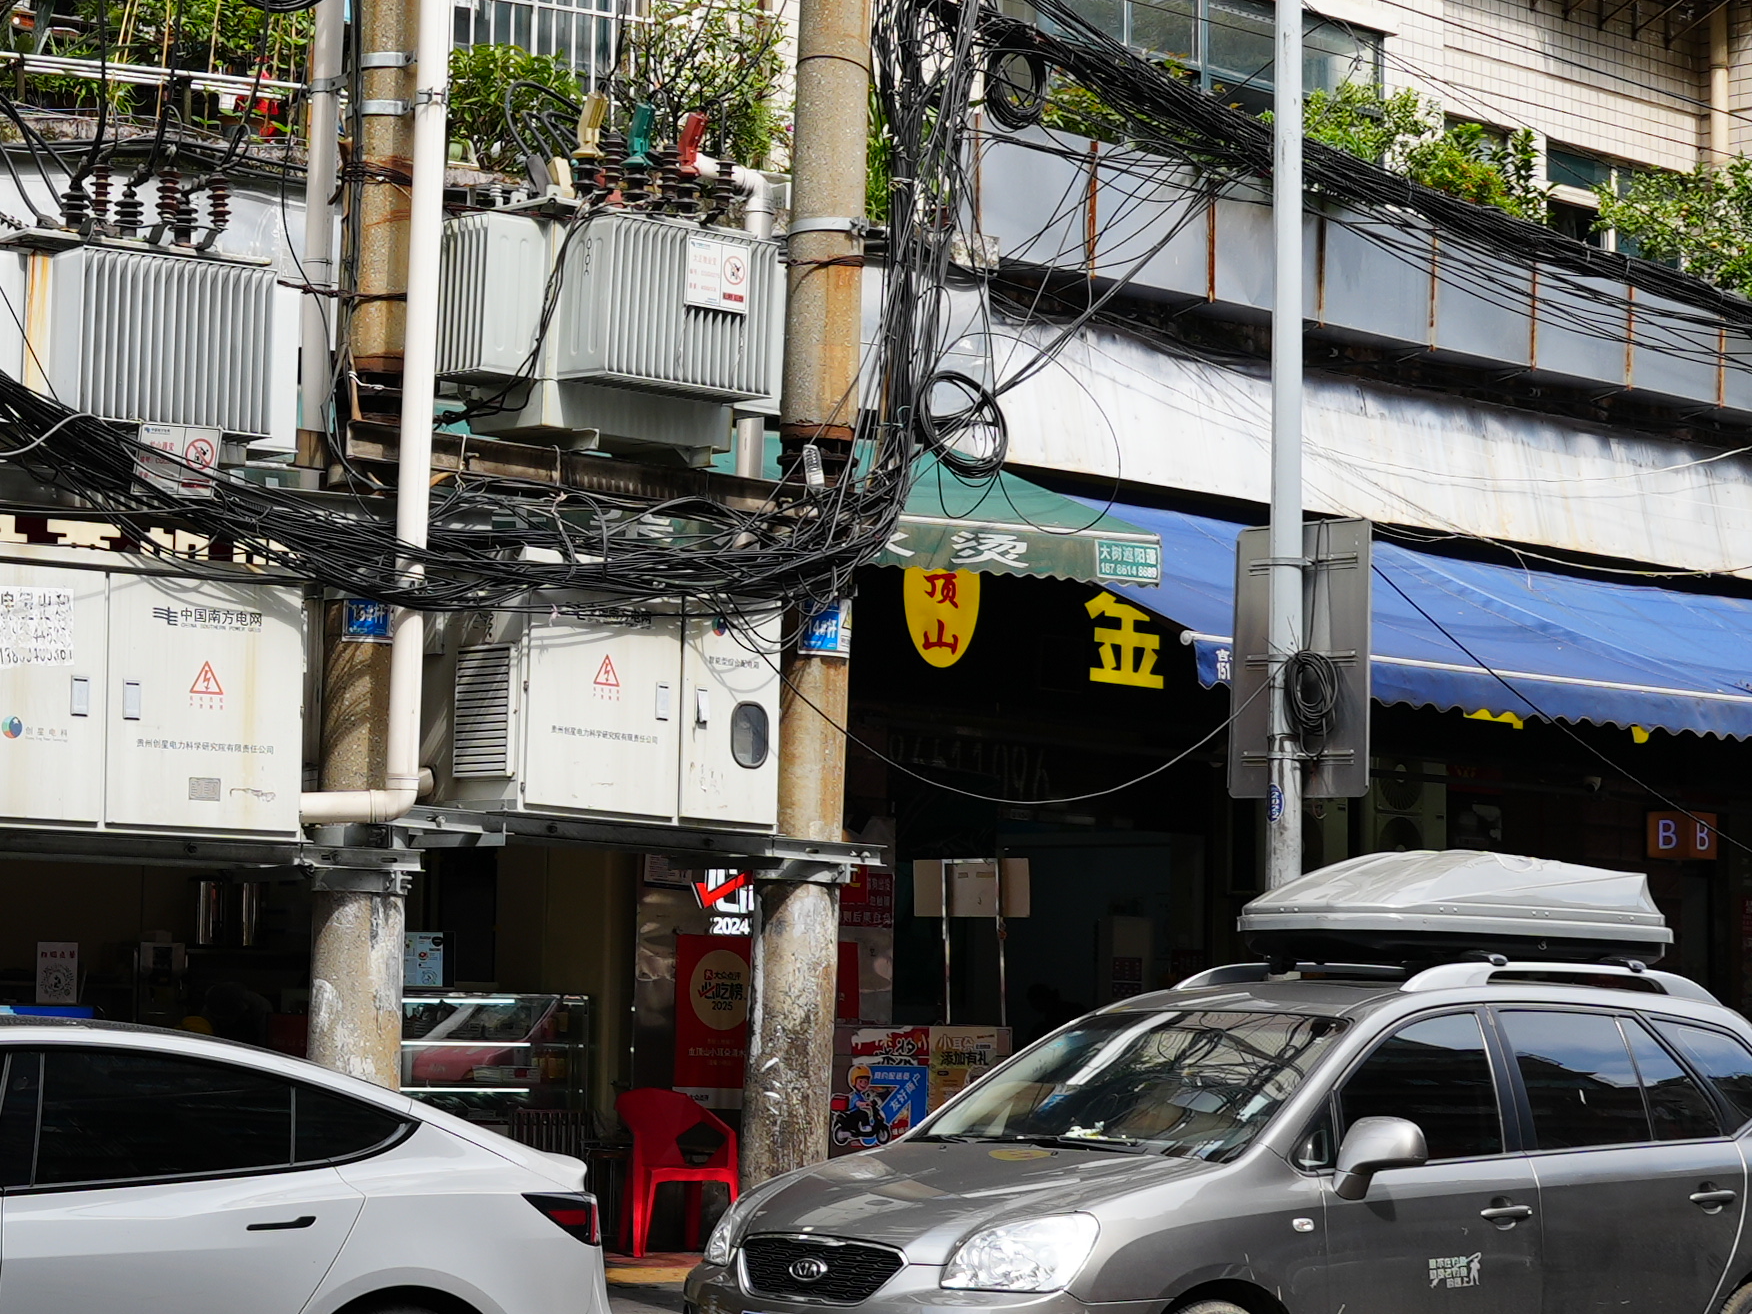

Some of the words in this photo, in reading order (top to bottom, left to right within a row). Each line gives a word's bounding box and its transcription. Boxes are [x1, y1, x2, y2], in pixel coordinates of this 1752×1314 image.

[180, 608, 263, 627] 中国南方电网
[922, 572, 960, 656] 顶山
[1083, 590, 1165, 690] 金
[1657, 819, 1678, 850] B
[712, 916, 751, 936] 2024
[711, 1000, 733, 1011] 2025
[940, 1051, 989, 1067] 添加有礼
[888, 1073, 923, 1112] 友好商户
